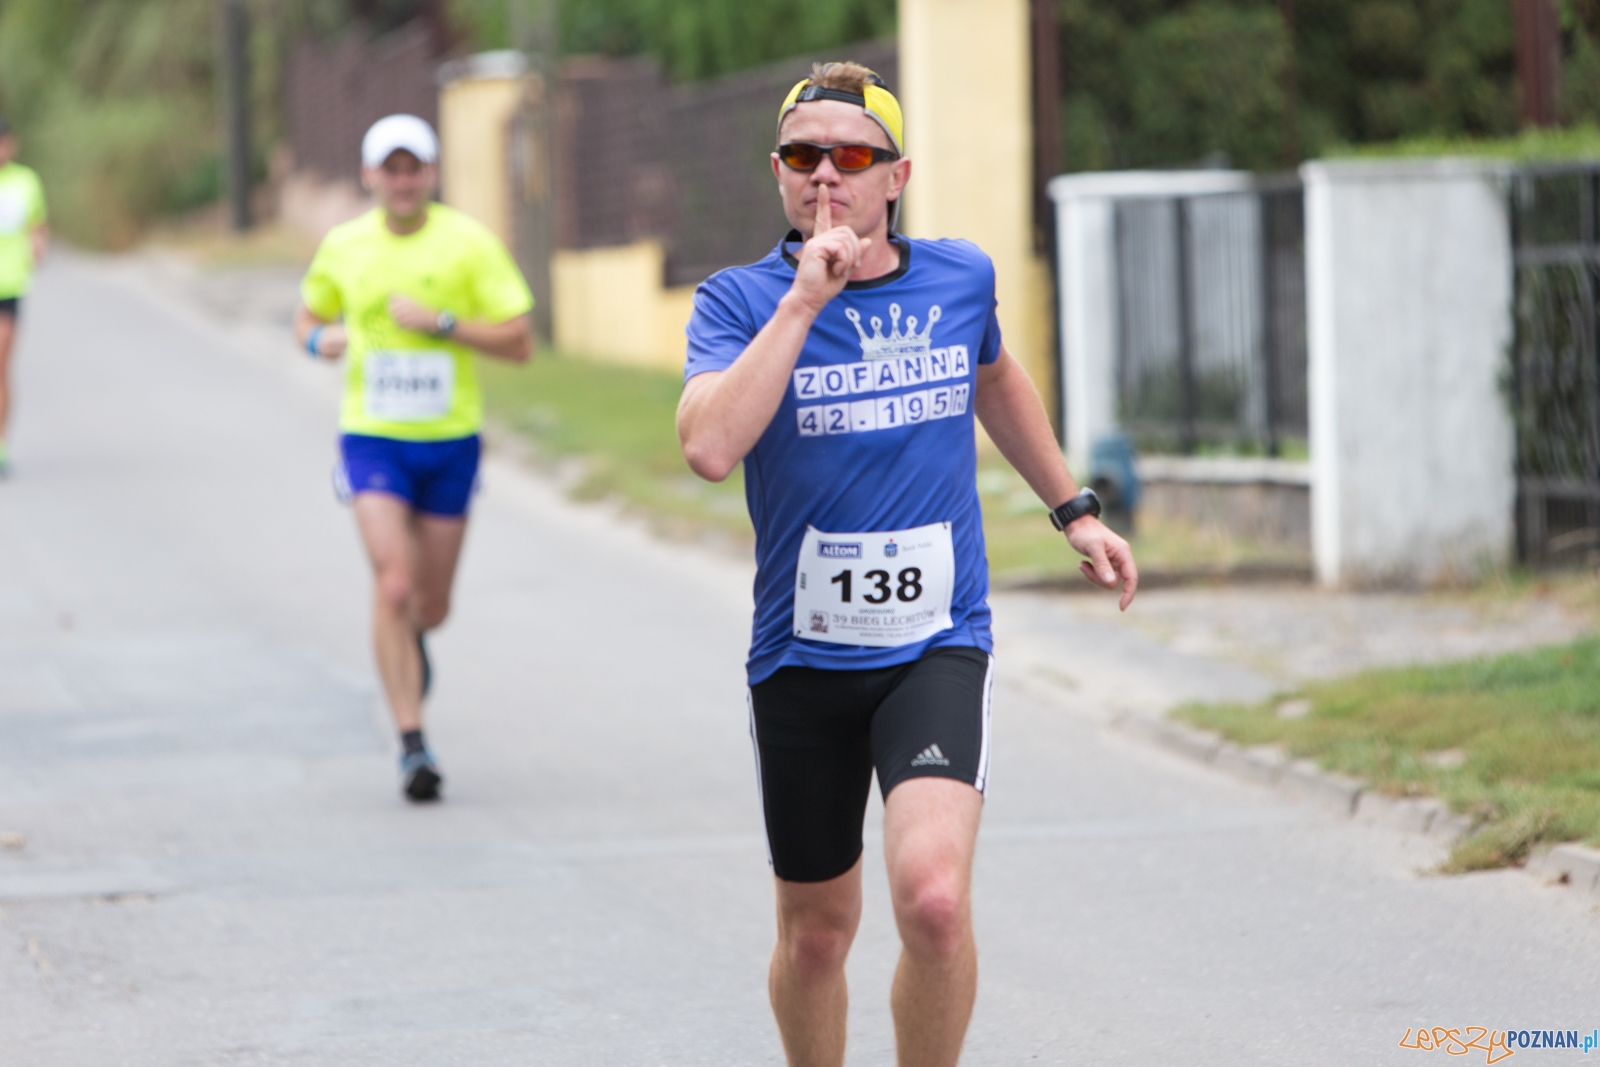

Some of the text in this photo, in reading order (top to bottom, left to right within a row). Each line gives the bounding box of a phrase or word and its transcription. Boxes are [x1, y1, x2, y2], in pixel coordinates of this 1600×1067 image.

[798, 350, 966, 395] ZOFANNA
[831, 567, 922, 604] 138
[832, 614, 848, 624] 39
[851, 615, 880, 626] BIEG
[911, 757, 950, 767] adidas
